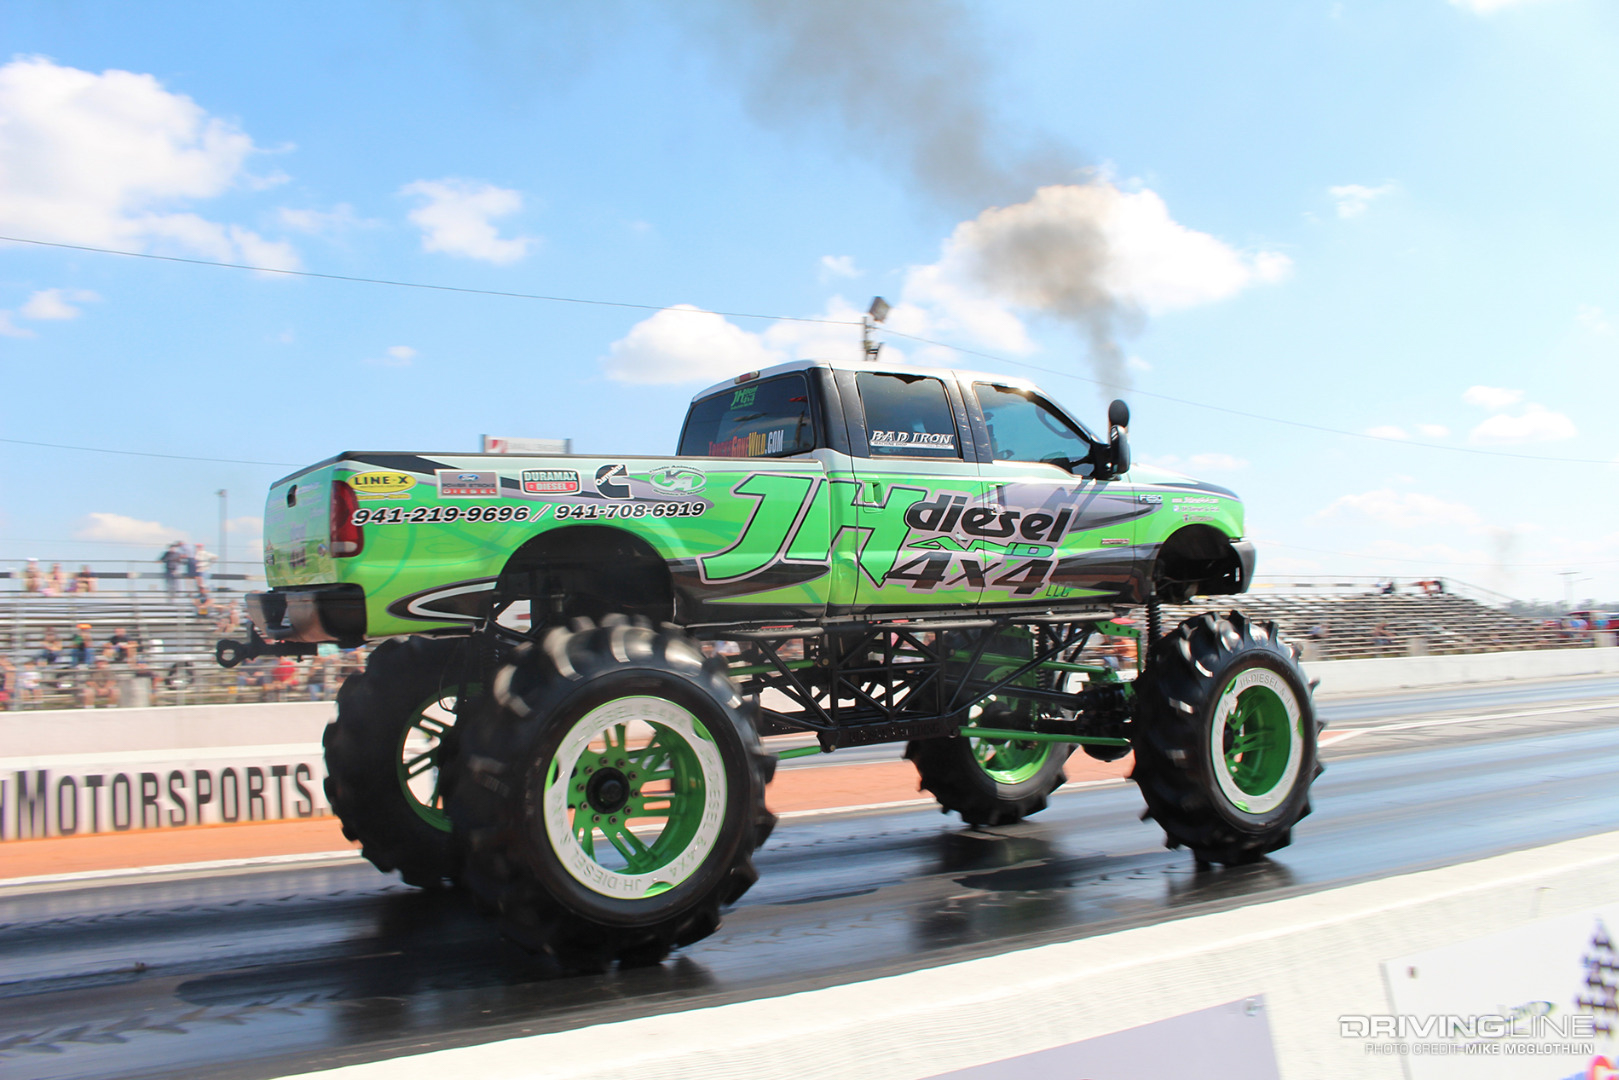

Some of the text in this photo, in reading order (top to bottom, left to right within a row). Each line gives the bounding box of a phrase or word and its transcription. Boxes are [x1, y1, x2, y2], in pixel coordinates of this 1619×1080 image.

[871, 430, 954, 444] BAD IRON
[524, 471, 578, 482] DURAMAX
[535, 482, 568, 491] DIESEL
[353, 507, 528, 525] 941-219-9696
[556, 502, 705, 519] 941-708-6919
[906, 494, 1074, 542] diesel
[701, 473, 928, 586] JH
